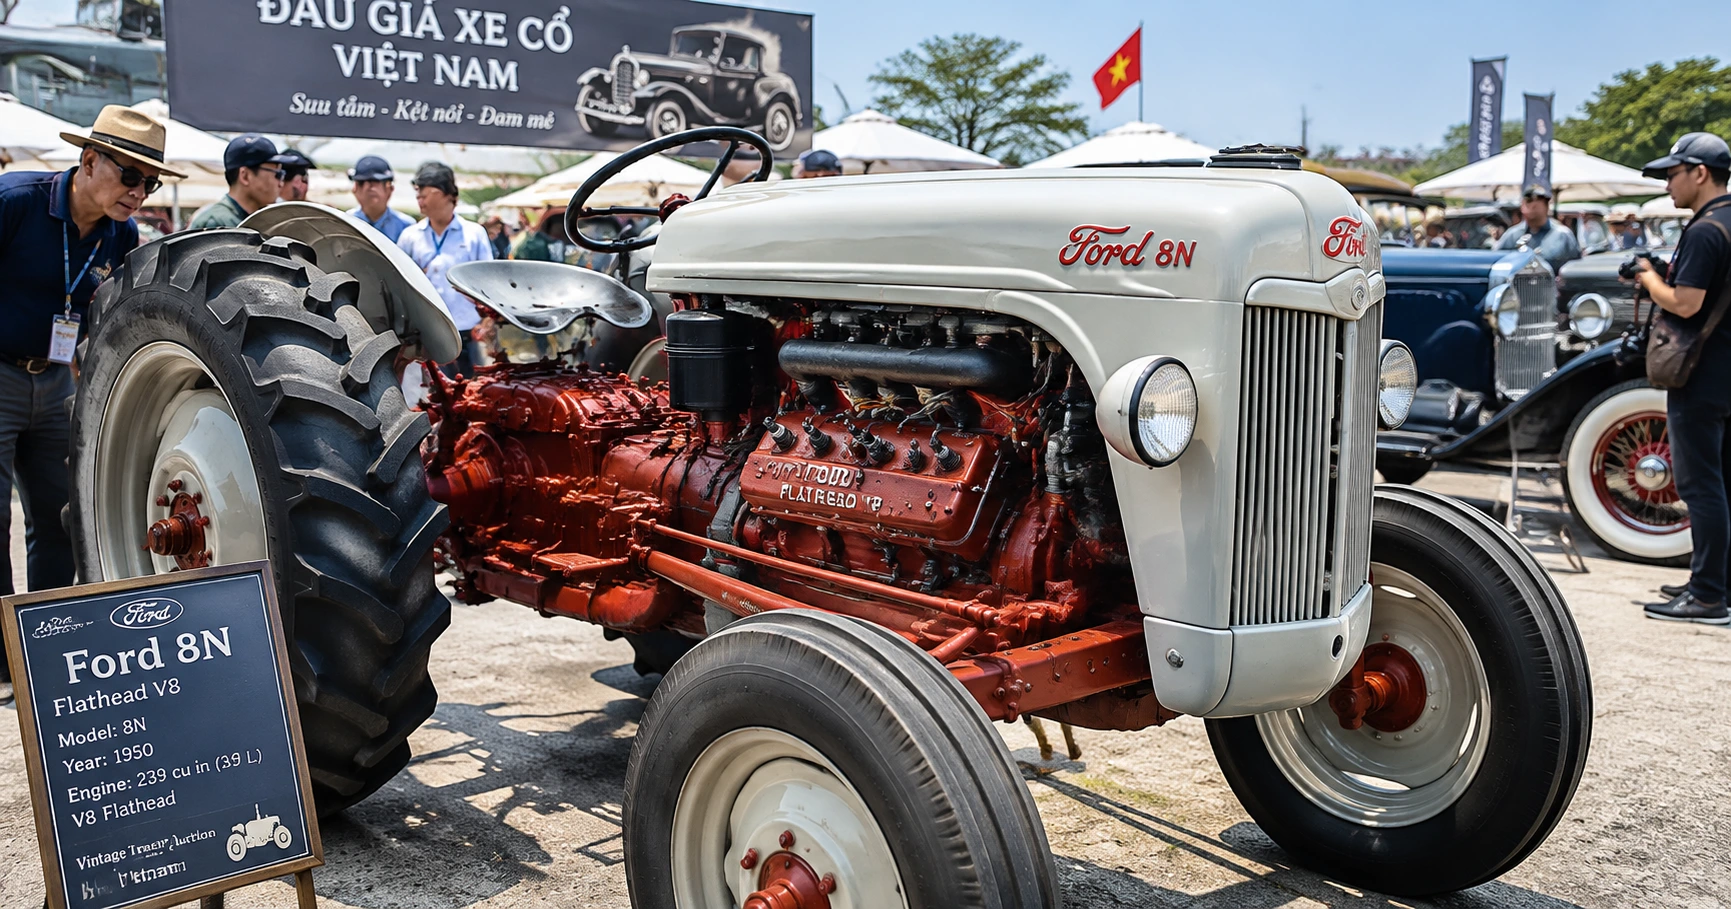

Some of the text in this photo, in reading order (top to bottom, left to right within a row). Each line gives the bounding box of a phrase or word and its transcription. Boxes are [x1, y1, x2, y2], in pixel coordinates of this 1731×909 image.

[453, 8, 509, 48] XE
[332, 41, 520, 92] VIỆT NAM
[1058, 224, 1197, 268] Ford 8N
[123, 602, 171, 625] Ford
[62, 626, 234, 685] Ford 8N
[53, 677, 182, 717] Flathead V8
[57, 716, 148, 748] Model: 8N
[62, 742, 154, 775] Year: 1950
[67, 777, 132, 804] Engine:
[136, 767, 168, 787] 239
[172, 766, 192, 780] cu
[194, 759, 211, 775] in
[246, 748, 263, 766] L)
[71, 790, 177, 828] V8 Flathead
[76, 849, 127, 871] Vintage
